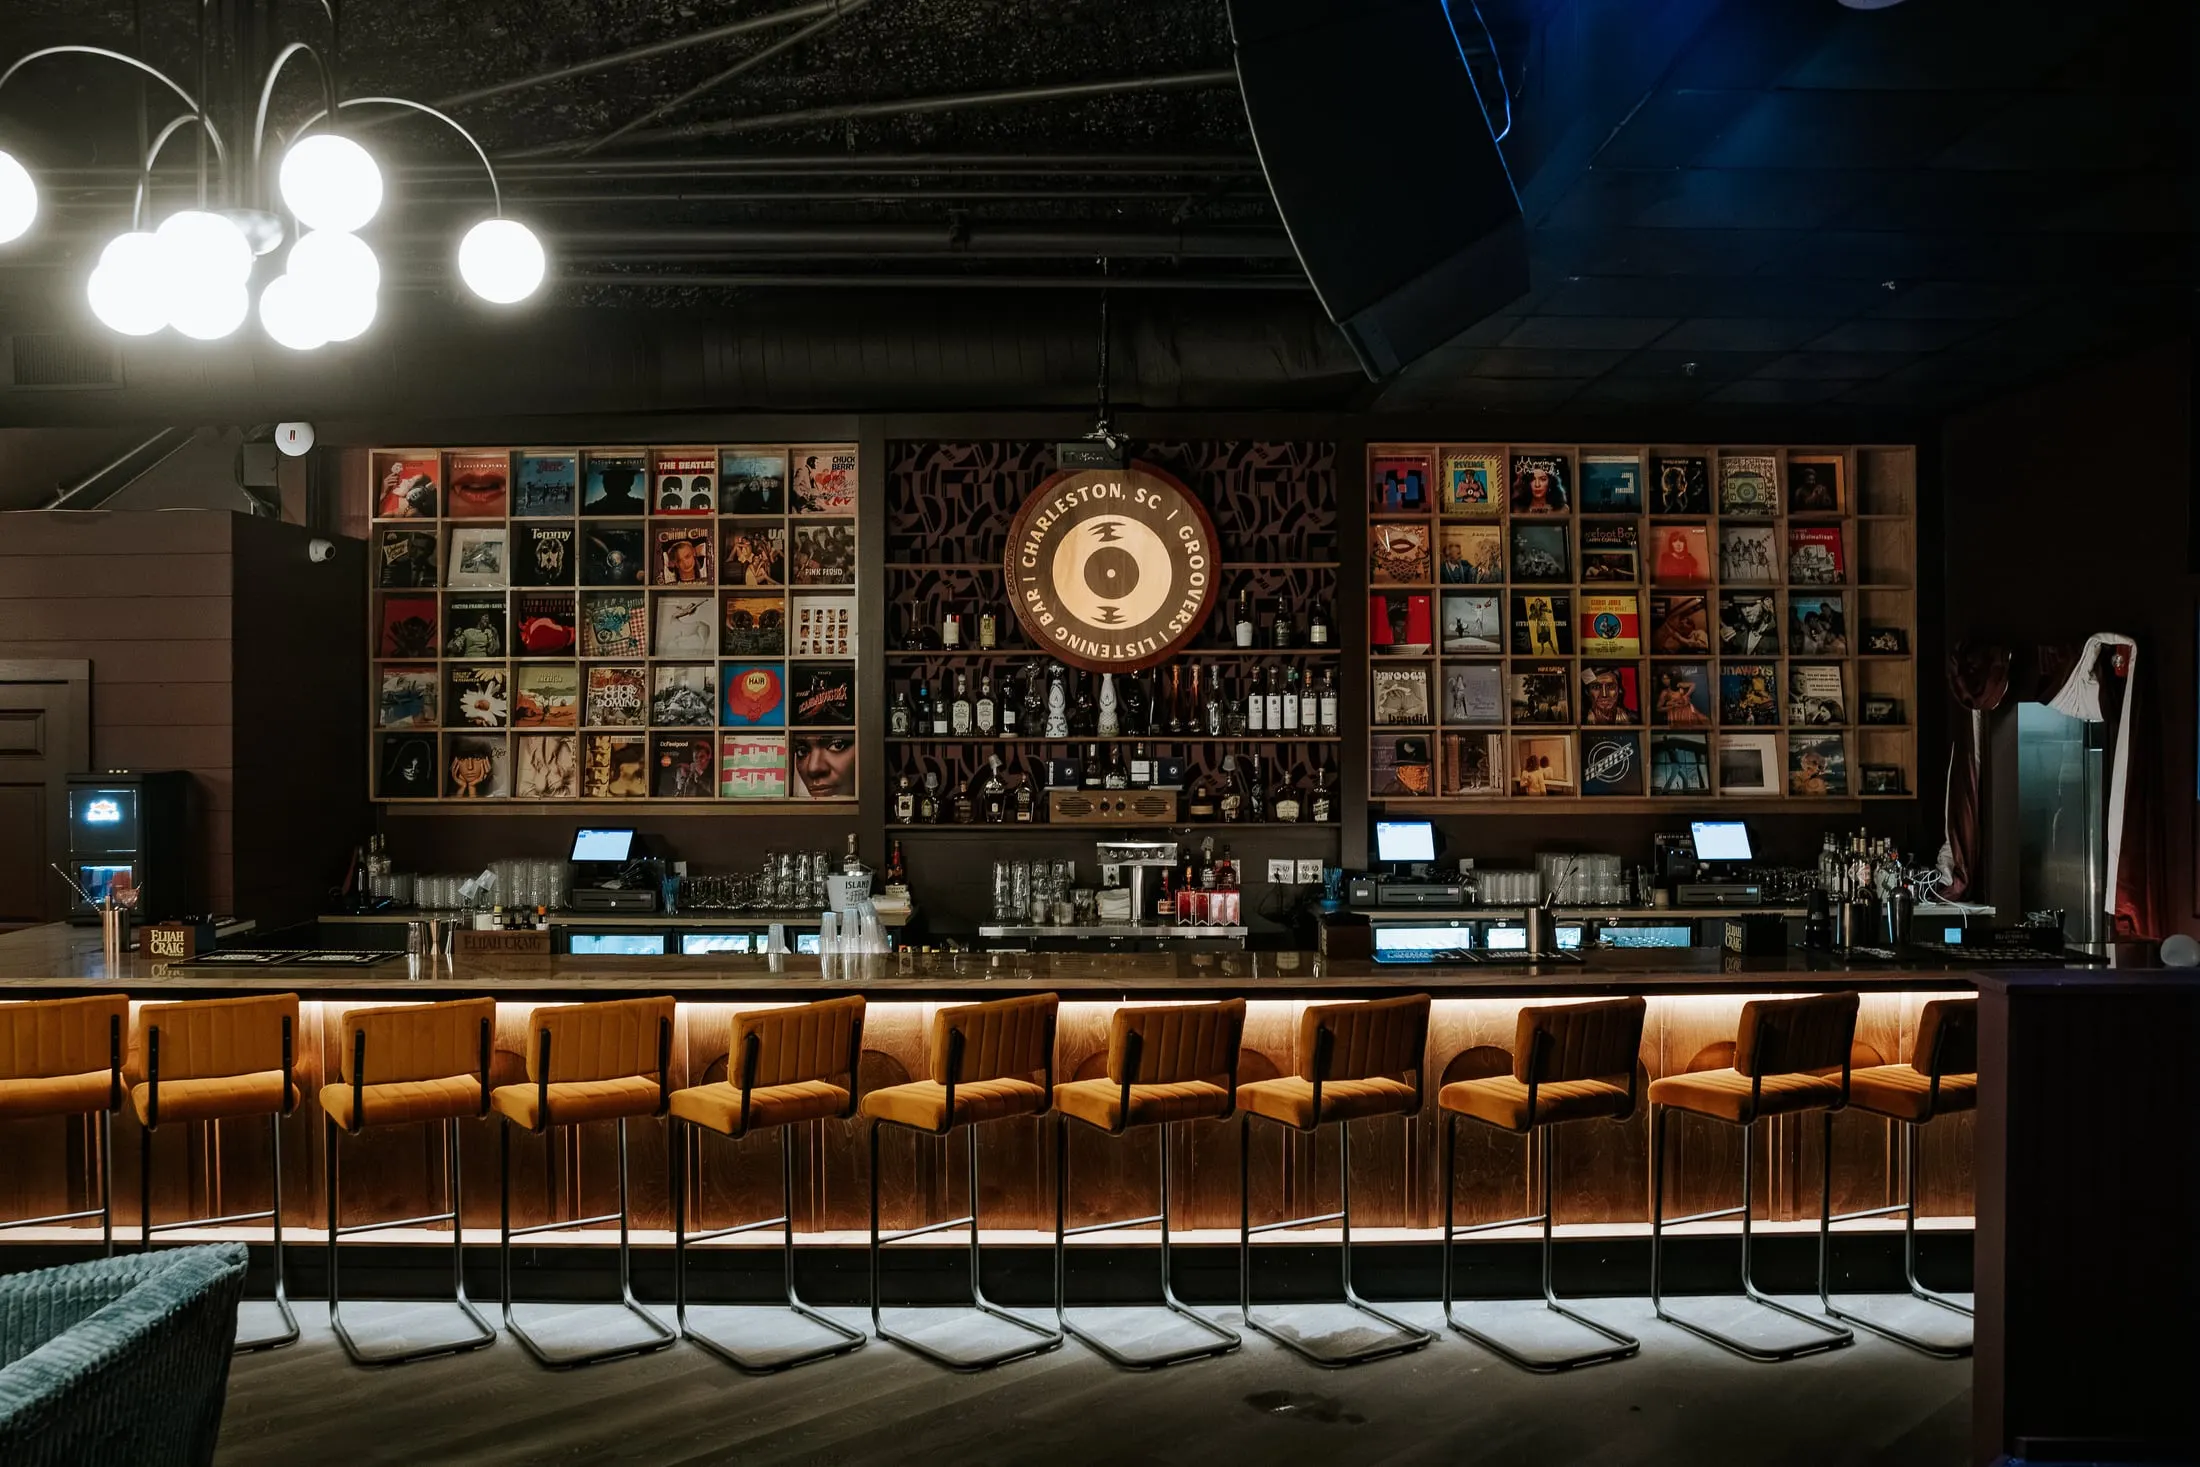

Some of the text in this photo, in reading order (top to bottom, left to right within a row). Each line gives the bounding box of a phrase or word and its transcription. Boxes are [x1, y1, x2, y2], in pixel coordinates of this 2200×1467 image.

[658, 461, 715, 470] THE BEATLES
[832, 463, 855, 471] BERRY
[1022, 483, 1126, 568] CHARLESTON,
[1134, 488, 1162, 510] SC
[531, 528, 572, 542] Tommy
[805, 568, 843, 576] PINK FLOYD
[1168, 525, 1205, 634] GROOVERS
[1026, 588, 1157, 659] LISTENING BAR
[748, 677, 765, 686] HAIR
[596, 699, 640, 708] DOMINO
[733, 746, 778, 764] FUN
[731, 771, 776, 791] FUN
[845, 880, 869, 890] ISLAND
[150, 930, 185, 943] ELIJAH
[504, 935, 541, 950] CRAIG
[150, 941, 185, 955] CRAIG
